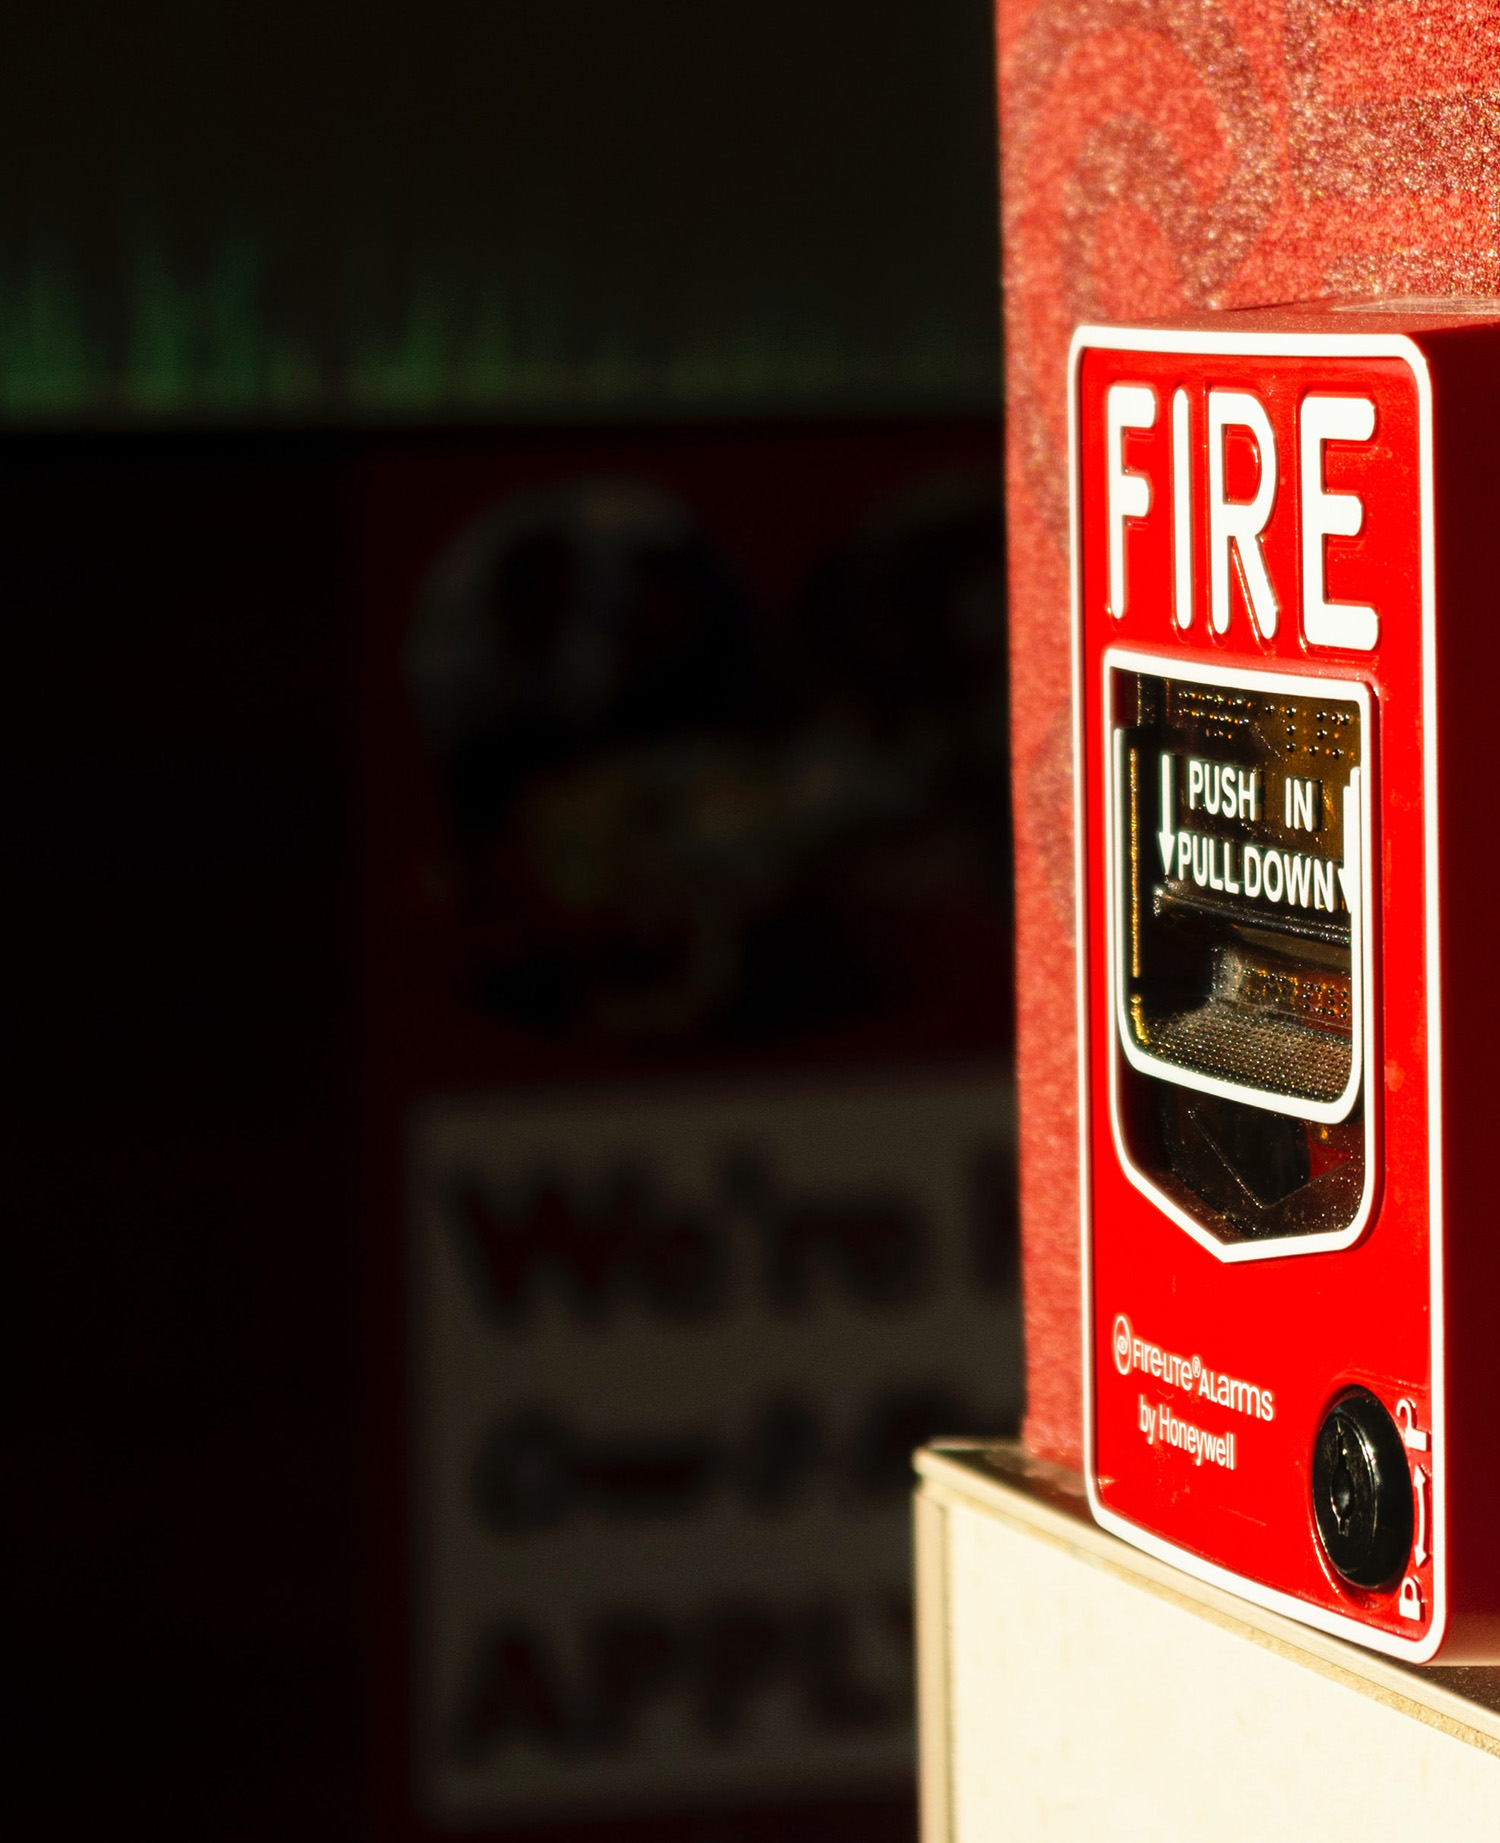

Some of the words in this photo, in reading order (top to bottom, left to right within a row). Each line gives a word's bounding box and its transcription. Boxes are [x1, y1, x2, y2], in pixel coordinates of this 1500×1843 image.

[1107, 385, 1381, 651] FIRE
[1188, 760, 1256, 821] PUSH
[1285, 777, 1313, 832] IN
[1177, 831, 1240, 894] PULL
[1244, 846, 1334, 913] DOWN
[1139, 1394, 1157, 1445] by
[1158, 1403, 1235, 1471] Honeywell
